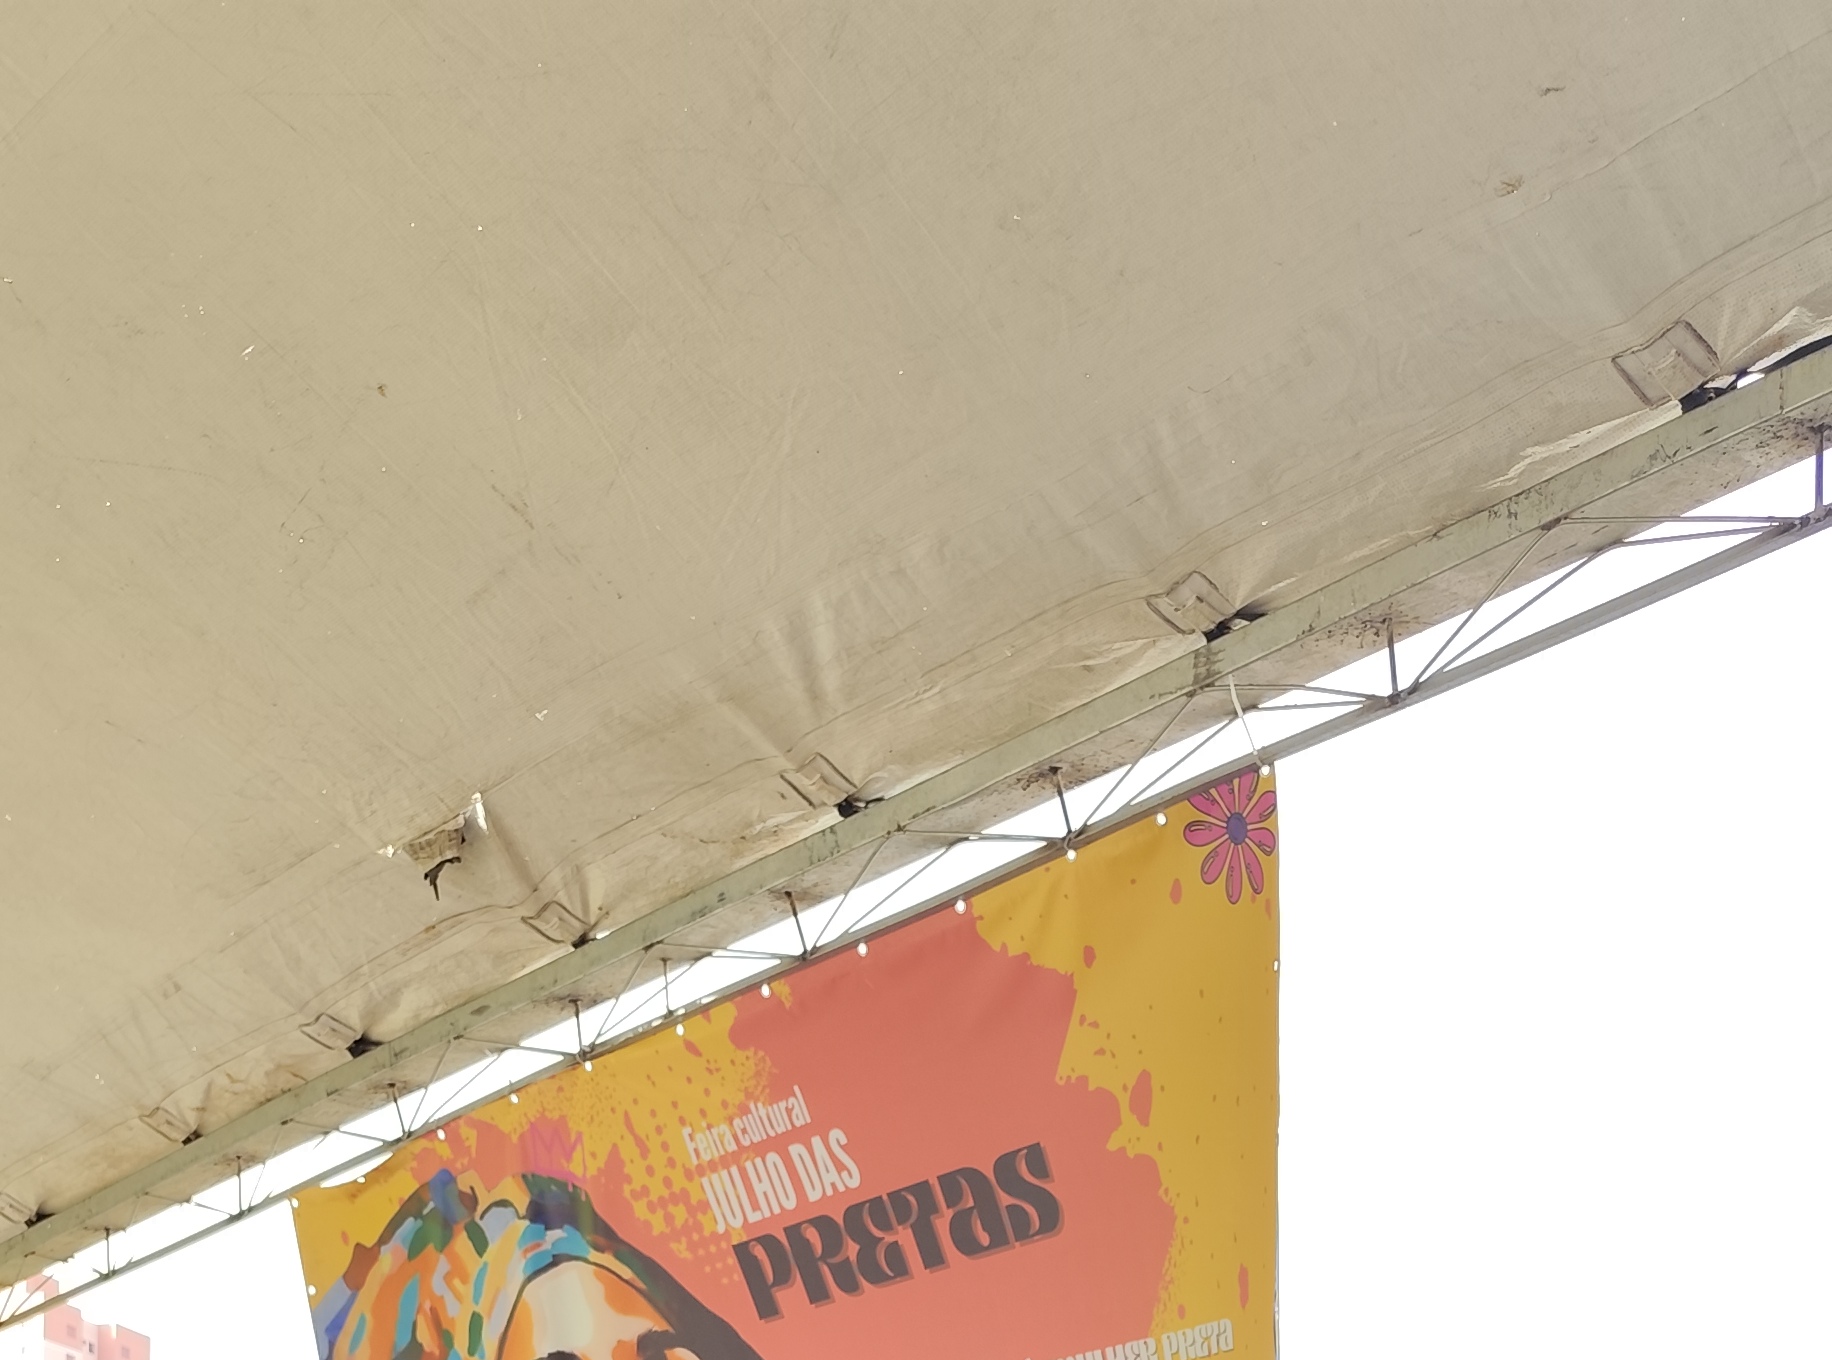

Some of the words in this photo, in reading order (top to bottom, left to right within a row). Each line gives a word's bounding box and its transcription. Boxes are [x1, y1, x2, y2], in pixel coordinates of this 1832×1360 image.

[682, 1120, 738, 1166] Feira
[732, 1084, 812, 1147] cultural
[701, 1151, 797, 1234] JULHO
[788, 1127, 861, 1203] DAS
[732, 1141, 1063, 1322] PRETAS
